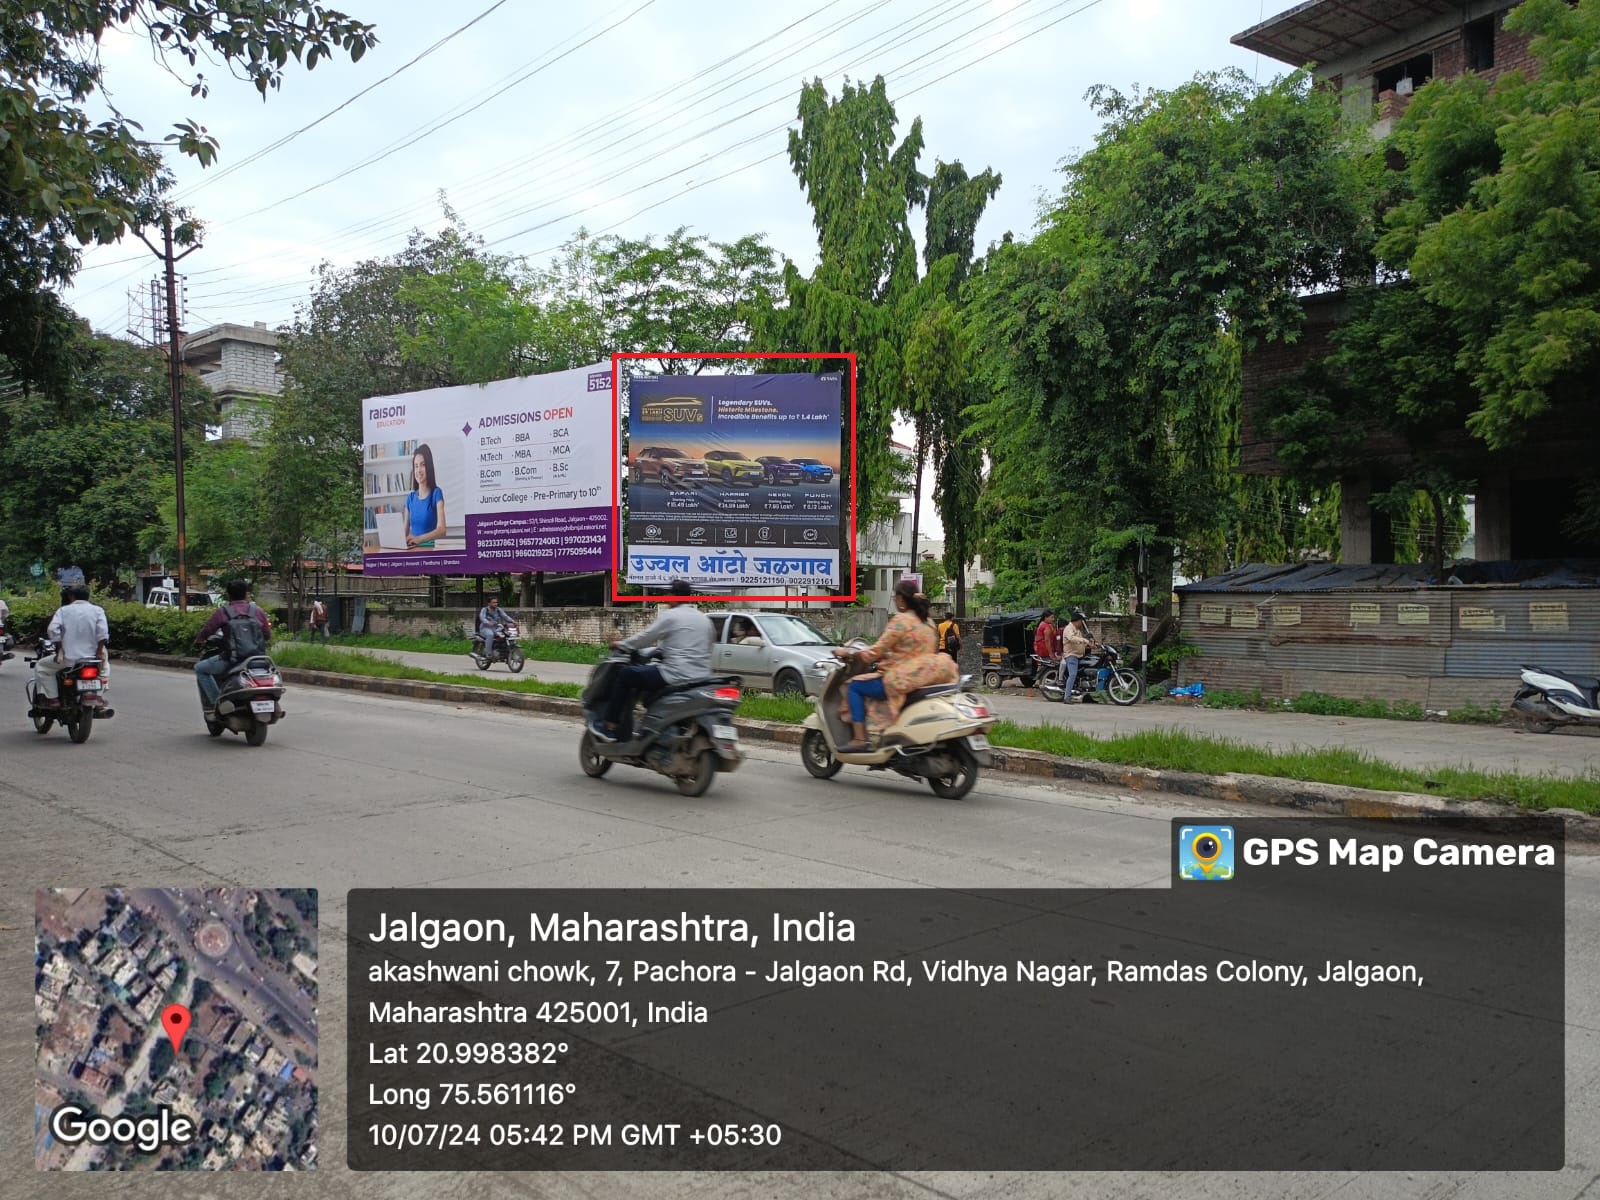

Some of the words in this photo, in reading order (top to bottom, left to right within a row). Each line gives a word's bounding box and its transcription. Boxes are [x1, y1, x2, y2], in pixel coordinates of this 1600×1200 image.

[589, 377, 612, 390] 5152
[479, 411, 541, 428] ADMISSIONS
[543, 407, 573, 420] OPEN
[480, 437, 502, 446] B.Tech
[515, 433, 530, 442] BBA
[553, 428, 569, 438] BCA
[480, 452, 503, 462] M.Tech
[514, 449, 532, 459] MBA
[553, 445, 571, 455] MCA
[480, 470, 501, 479] B.Com
[514, 466, 537, 476] B.Com
[553, 463, 569, 472] B.Sc
[480, 494, 501, 504] Junior
[502, 492, 528, 503] College
[533, 490, 578, 501] Pre-Primary
[580, 489, 588, 498] to
[697, 550, 747, 574] ऑटो
[753, 557, 832, 575] जळगाव
